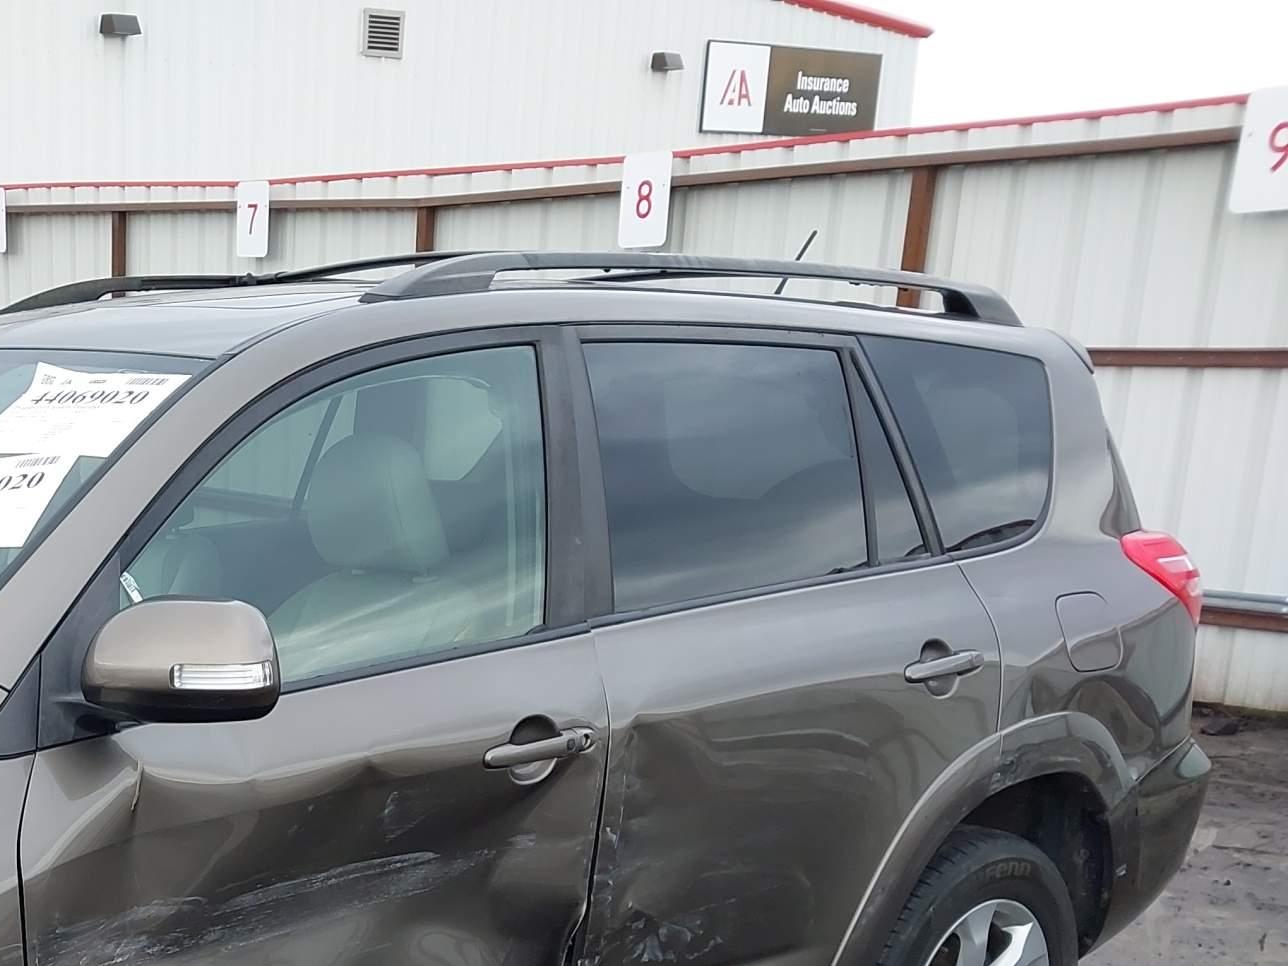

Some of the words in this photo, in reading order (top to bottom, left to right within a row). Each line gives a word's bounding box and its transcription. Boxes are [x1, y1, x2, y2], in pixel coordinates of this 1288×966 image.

[797, 71, 849, 92] Insurance
[784, 93, 810, 113] Auto
[812, 95, 858, 116] Auctions
[1269, 121, 1288, 173] 9
[636, 180, 653, 219] 8
[247, 204, 258, 235] 7
[31, 390, 150, 405] 44069020
